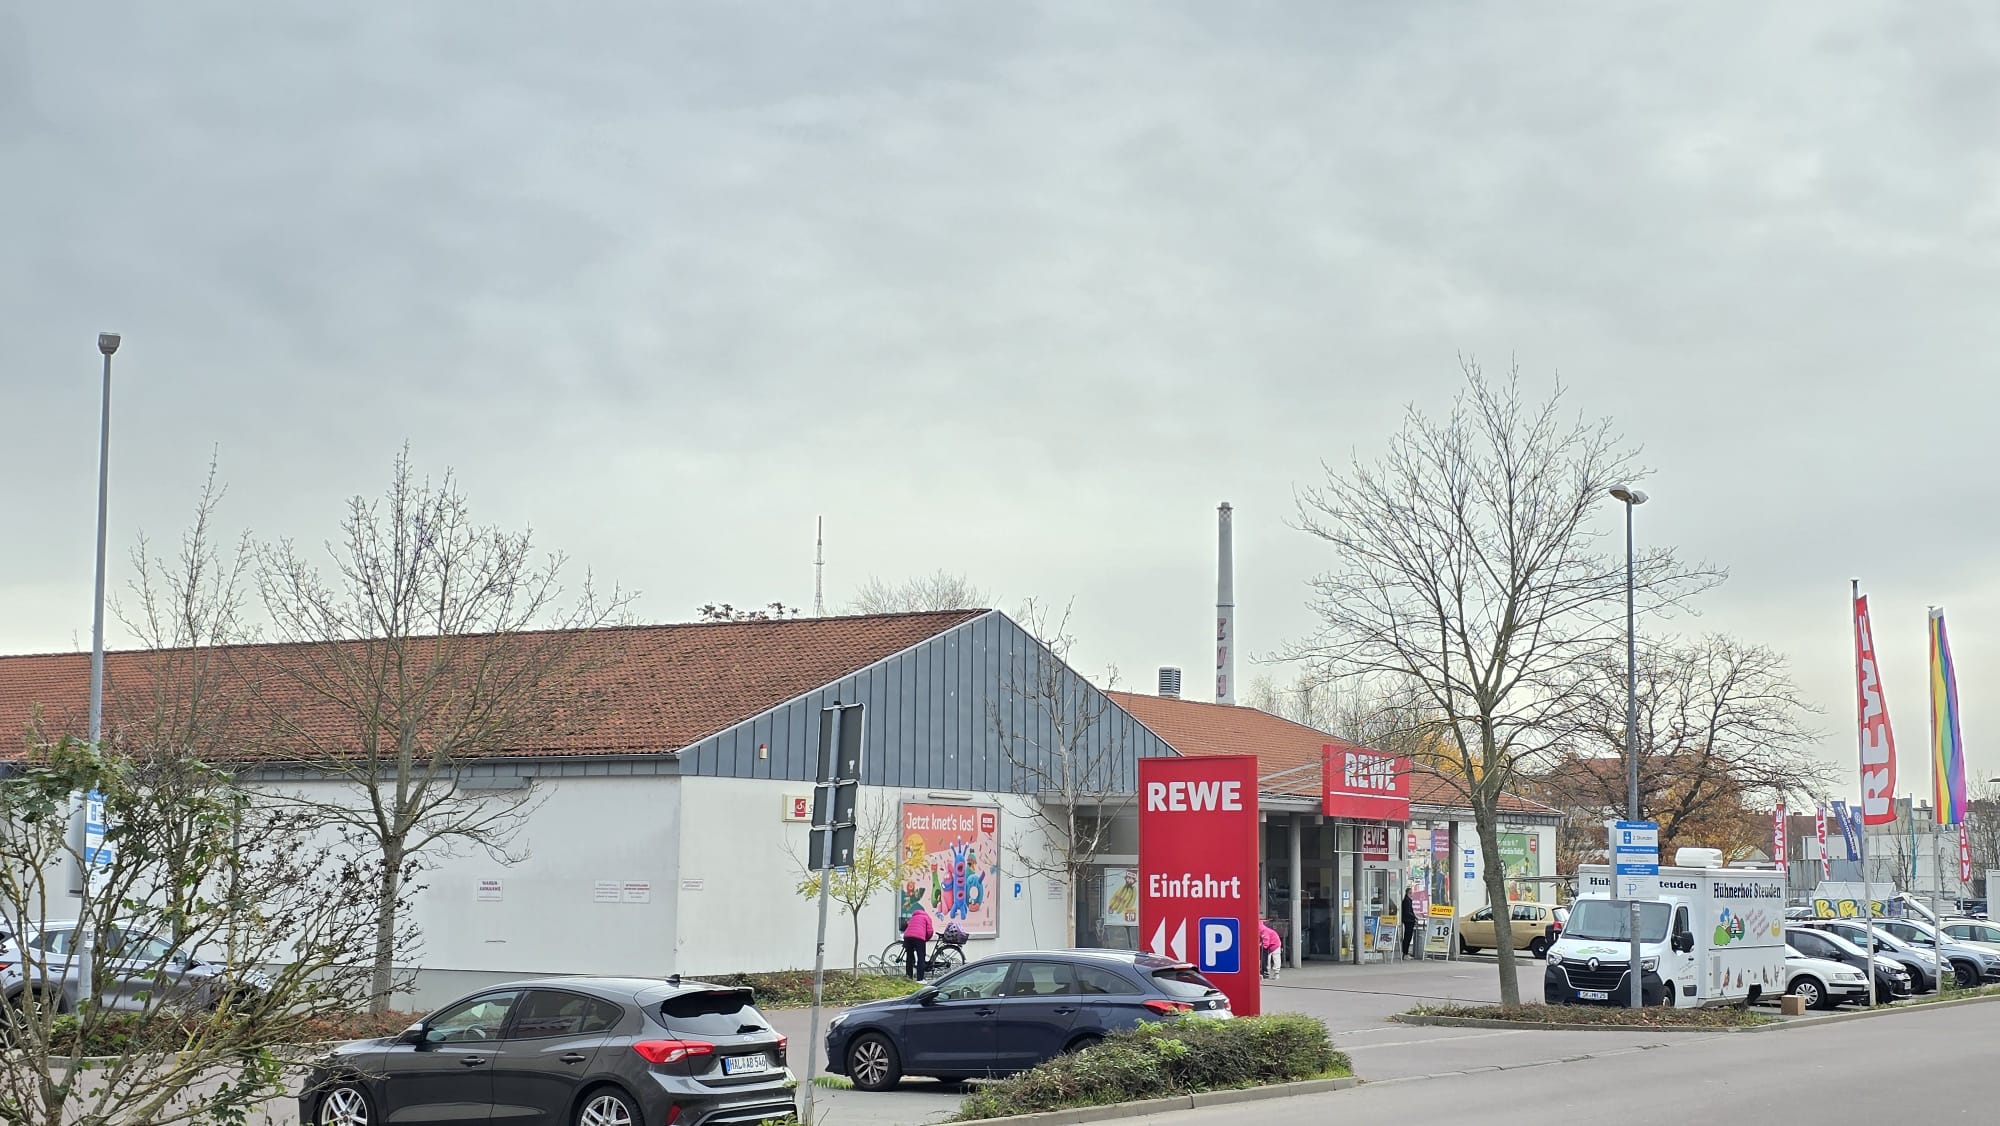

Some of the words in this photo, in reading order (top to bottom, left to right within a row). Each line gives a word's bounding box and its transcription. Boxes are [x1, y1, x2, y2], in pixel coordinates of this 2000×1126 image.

[1344, 752, 1396, 791] REWE
[1147, 781, 1243, 812] REWE
[905, 812, 930, 831] Jetzt
[931, 815, 957, 832] knet's
[959, 817, 974, 831] los!
[1149, 873, 1241, 899] Einfahrt
[1659, 880, 1697, 890] teuden
[1713, 882, 1753, 899] Hühnerhof
[1754, 885, 1781, 898] Steuden
[1436, 926, 1450, 936] 18
[1205, 924, 1233, 967] P
